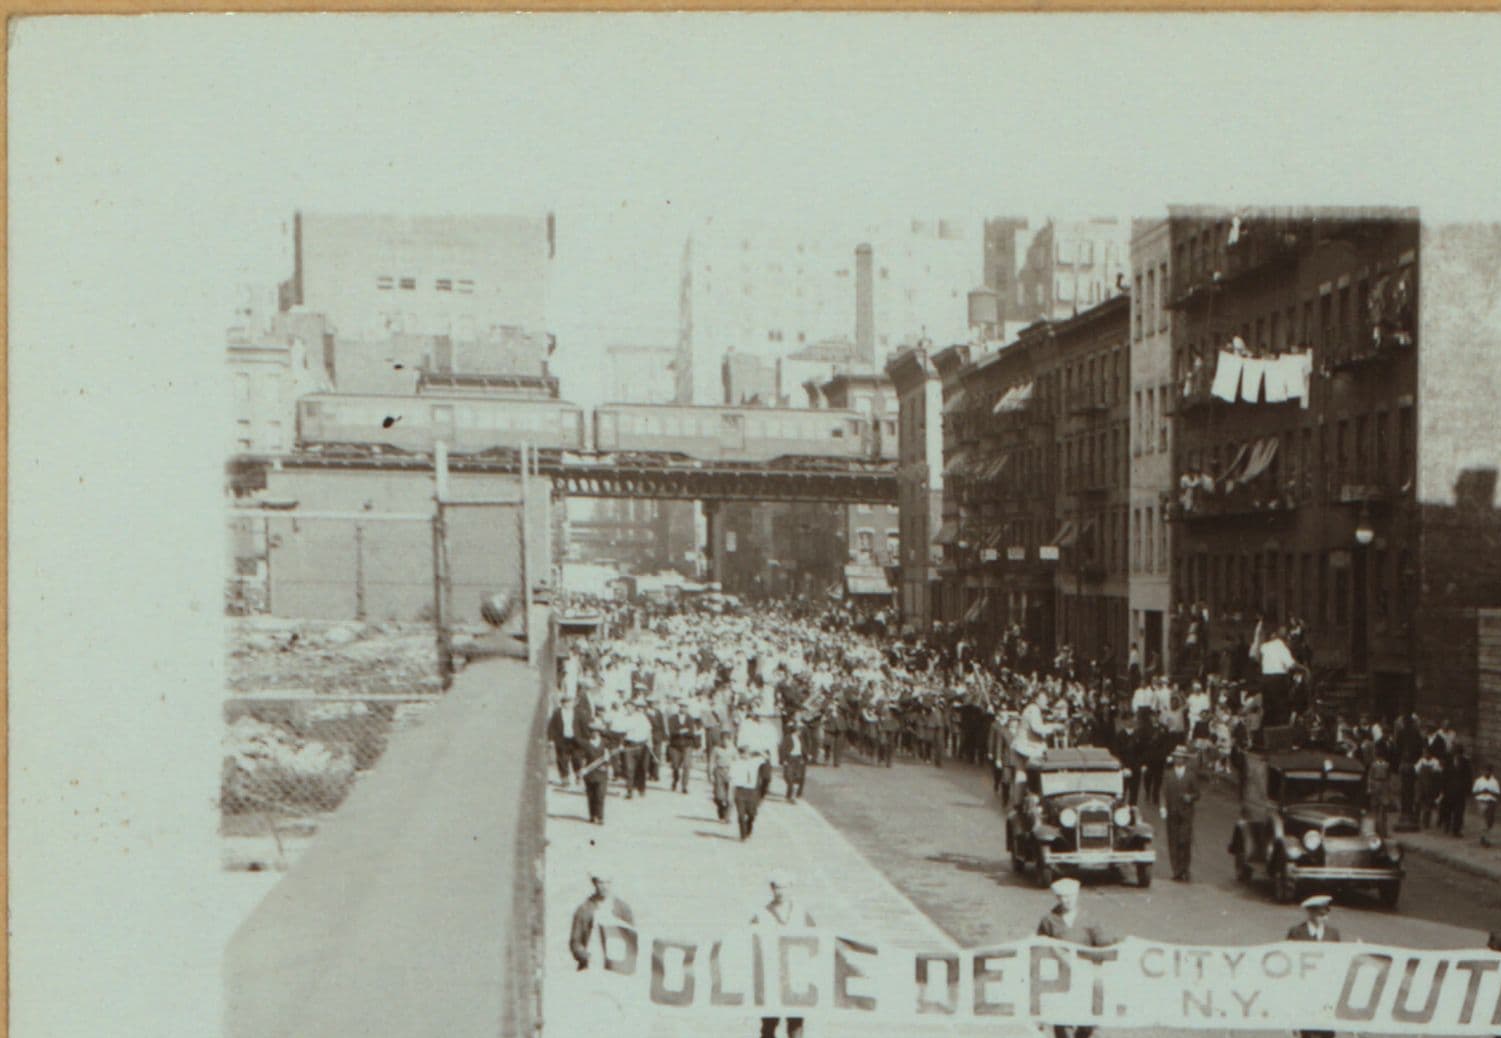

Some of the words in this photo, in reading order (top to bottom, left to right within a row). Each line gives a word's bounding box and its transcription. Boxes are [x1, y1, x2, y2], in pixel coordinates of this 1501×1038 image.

[600, 925, 879, 1011] POLICE
[915, 945, 1127, 1016] DEPT.
[1139, 946, 1248, 980] CITY
[1261, 950, 1325, 980] OF
[1182, 989, 1270, 1019] N.Y.
